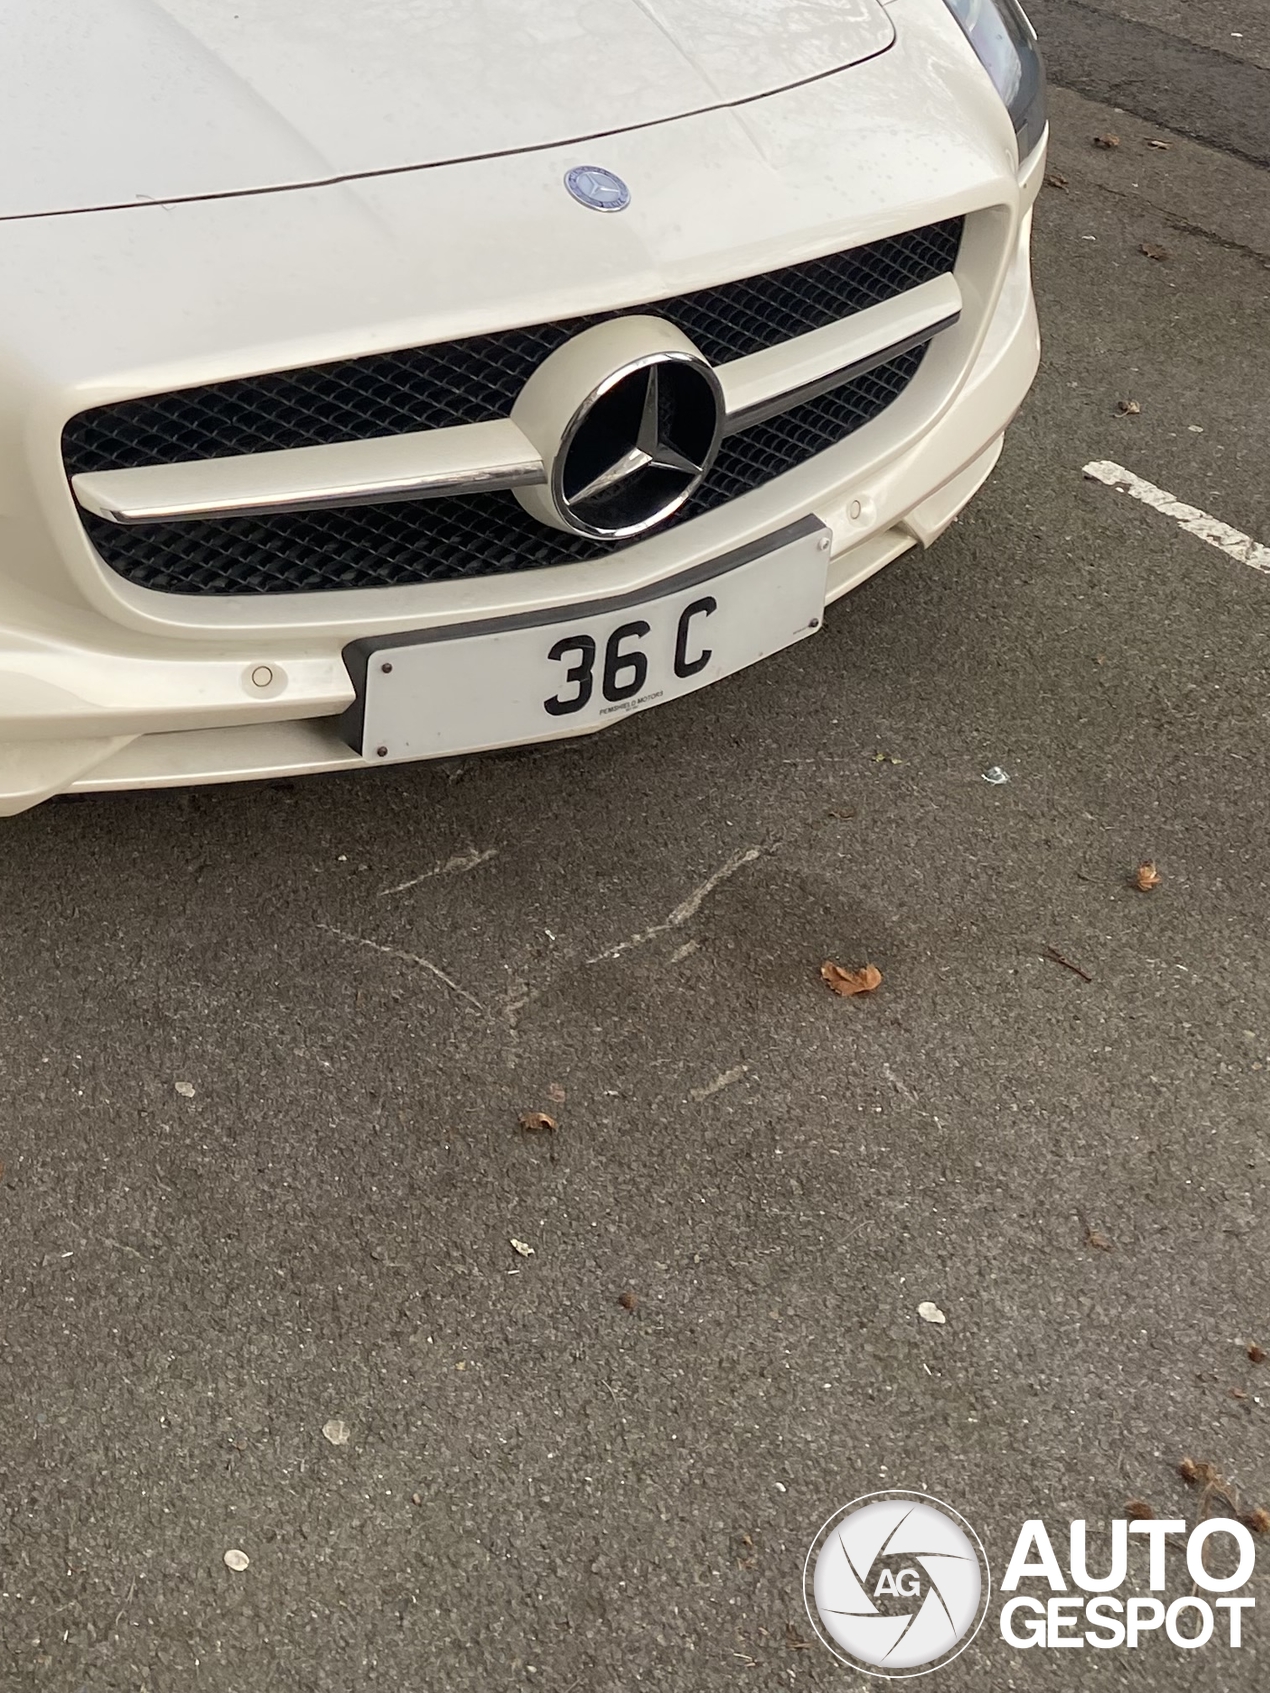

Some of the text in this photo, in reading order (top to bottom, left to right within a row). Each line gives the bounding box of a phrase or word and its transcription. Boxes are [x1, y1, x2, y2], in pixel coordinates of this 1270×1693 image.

[544, 596, 717, 716] 36 C
[637, 690, 664, 704] MOTORS
